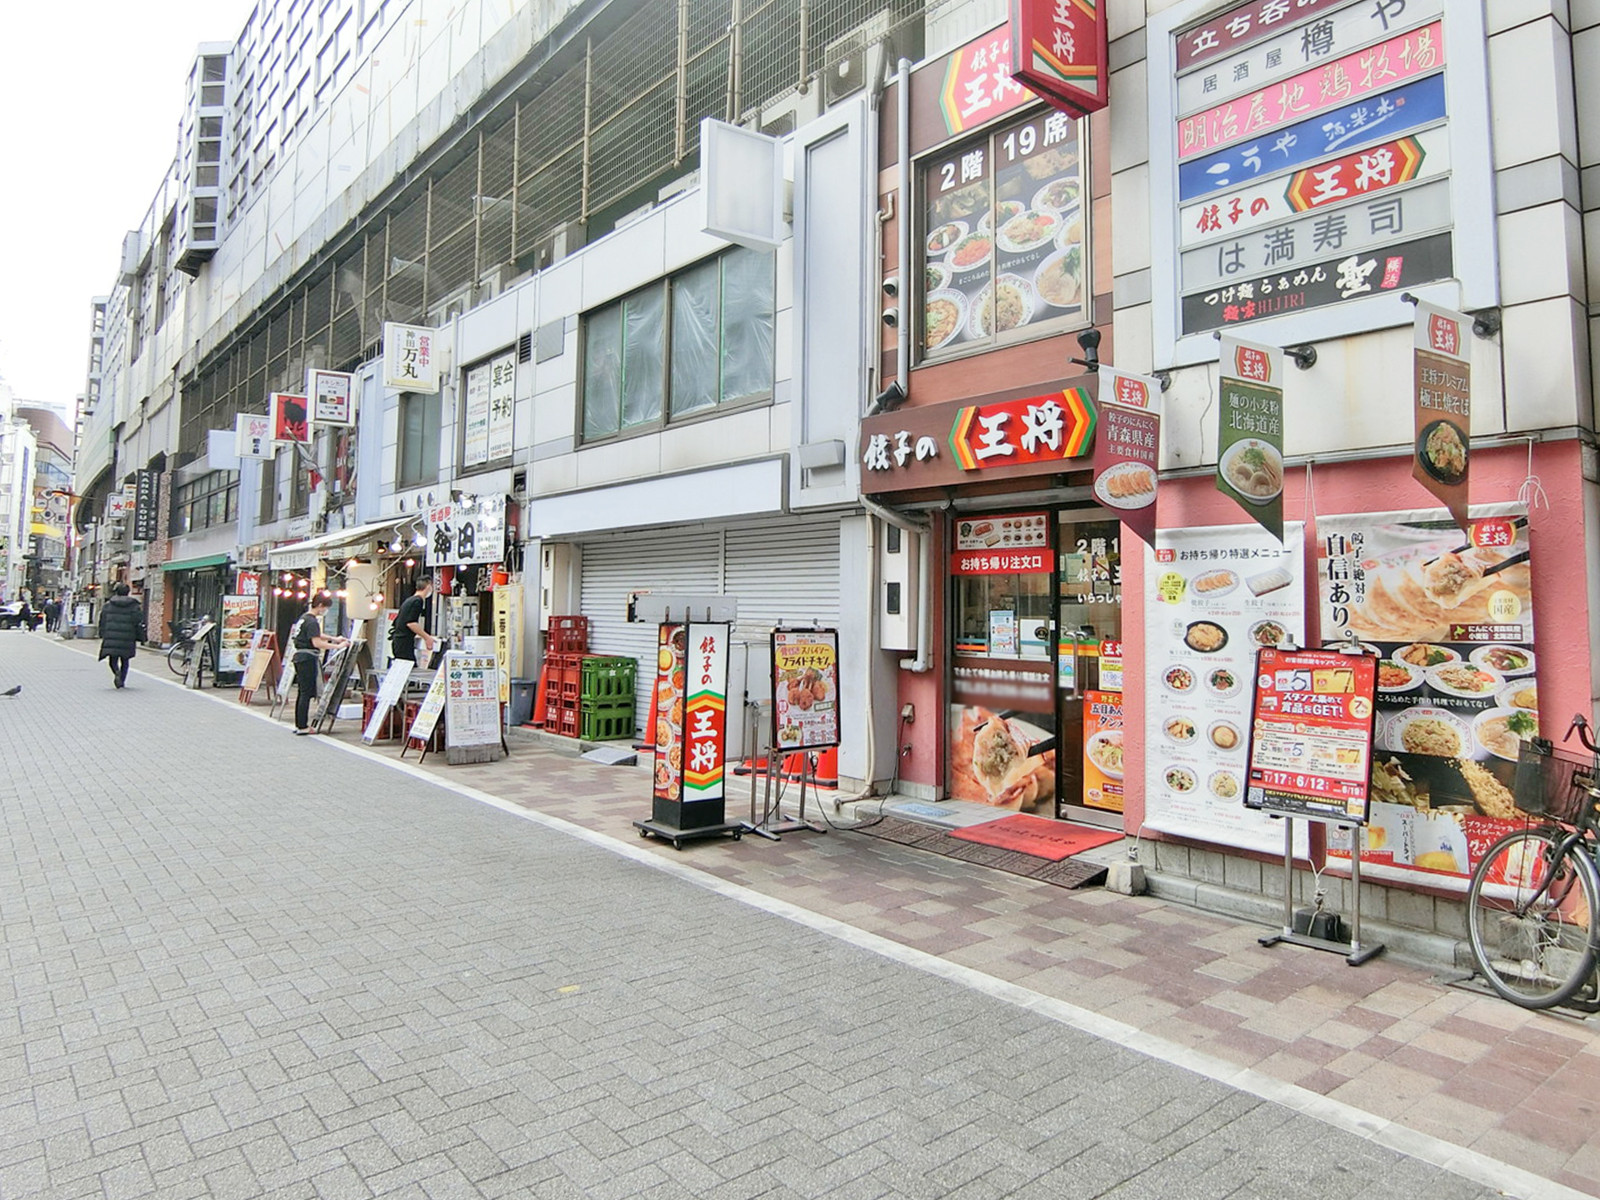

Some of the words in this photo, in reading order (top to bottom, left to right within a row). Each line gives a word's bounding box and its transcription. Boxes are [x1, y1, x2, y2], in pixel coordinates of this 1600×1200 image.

[1203, 48, 1282, 93] 居酒屋
[1183, 28, 1437, 150] 明治屋地鶏牧場
[941, 150, 984, 192] 2階
[1003, 112, 1068, 161] 19席
[1196, 197, 1269, 233] 餃子の
[1311, 149, 1395, 204] 王将
[1218, 198, 1403, 276] は満寿司
[1335, 256, 1377, 299] 聖
[493, 361, 513, 388] 宴会
[1242, 360, 1265, 380] 王将
[1121, 388, 1142, 405] 王将
[1229, 392, 1279, 416] 麺の小麦粉
[863, 429, 936, 471] 餃子の
[974, 400, 1063, 460] 王将
[1106, 424, 1155, 449] 青森県産
[1108, 412, 1154, 430] 餃子のにんにく
[1229, 410, 1280, 436] 北海道産
[141, 472, 149, 500] KANDA
[1180, 548, 1292, 561] お持ち帰り特選メニュー
[1478, 532, 1509, 545] 王将
[960, 555, 1042, 571] お持ち帰り注文口
[1350, 532, 1366, 604] 餃子に絶対の
[1326, 532, 1353, 638] 自信あり。
[700, 636, 716, 685] 餃子の
[690, 710, 717, 771] 王将
